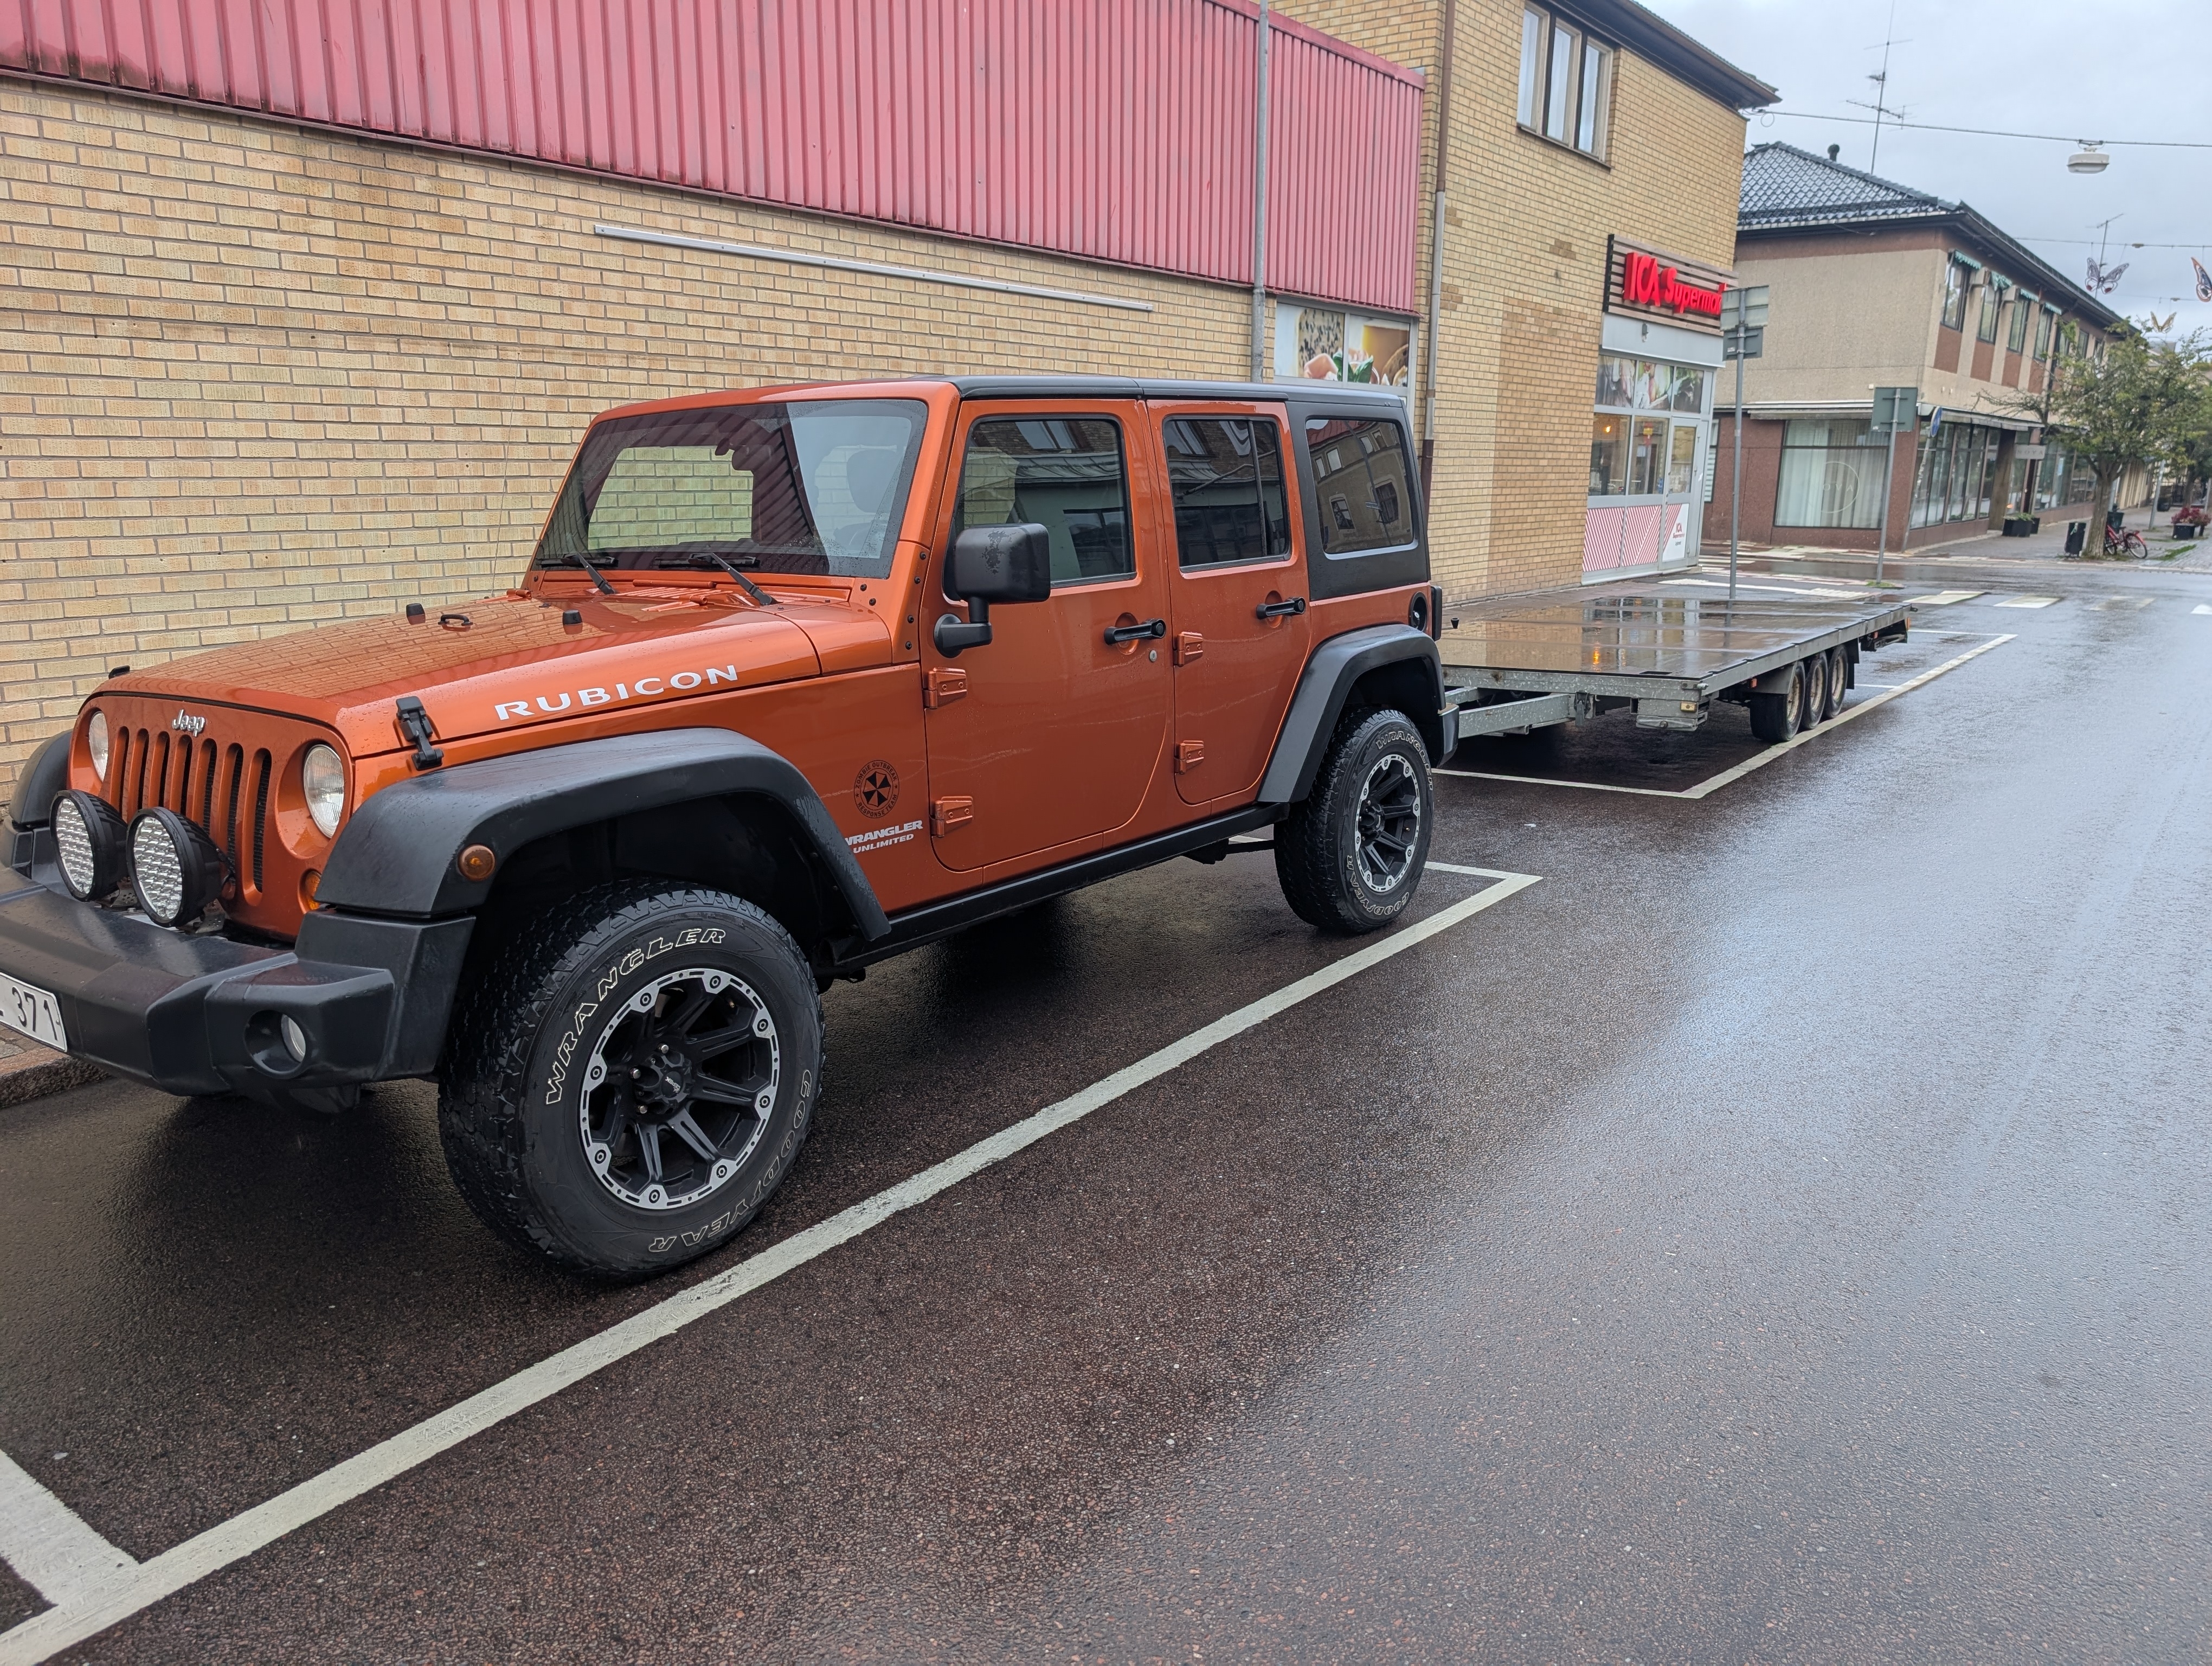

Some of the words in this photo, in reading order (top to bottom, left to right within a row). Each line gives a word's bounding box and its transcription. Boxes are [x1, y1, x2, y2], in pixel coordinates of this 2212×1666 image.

[1624, 252, 1661, 307] ICA
[1661, 267, 1727, 315] Supermar
[494, 665, 738, 721] RUBICON
[171, 709, 205, 738] Jeep
[855, 765, 871, 789] ZOMBIE
[872, 761, 898, 781] OUTBREAK
[1375, 731, 1434, 791] WRANGLER
[858, 802, 885, 818] RESPONSE
[885, 794, 898, 811] TEAM
[853, 834, 914, 854] UNLIMITED
[1346, 855, 1410, 915] GOODYEAR
[545, 928, 726, 1105] WRANGLER
[648, 1069, 812, 1253] GOODYEAR
